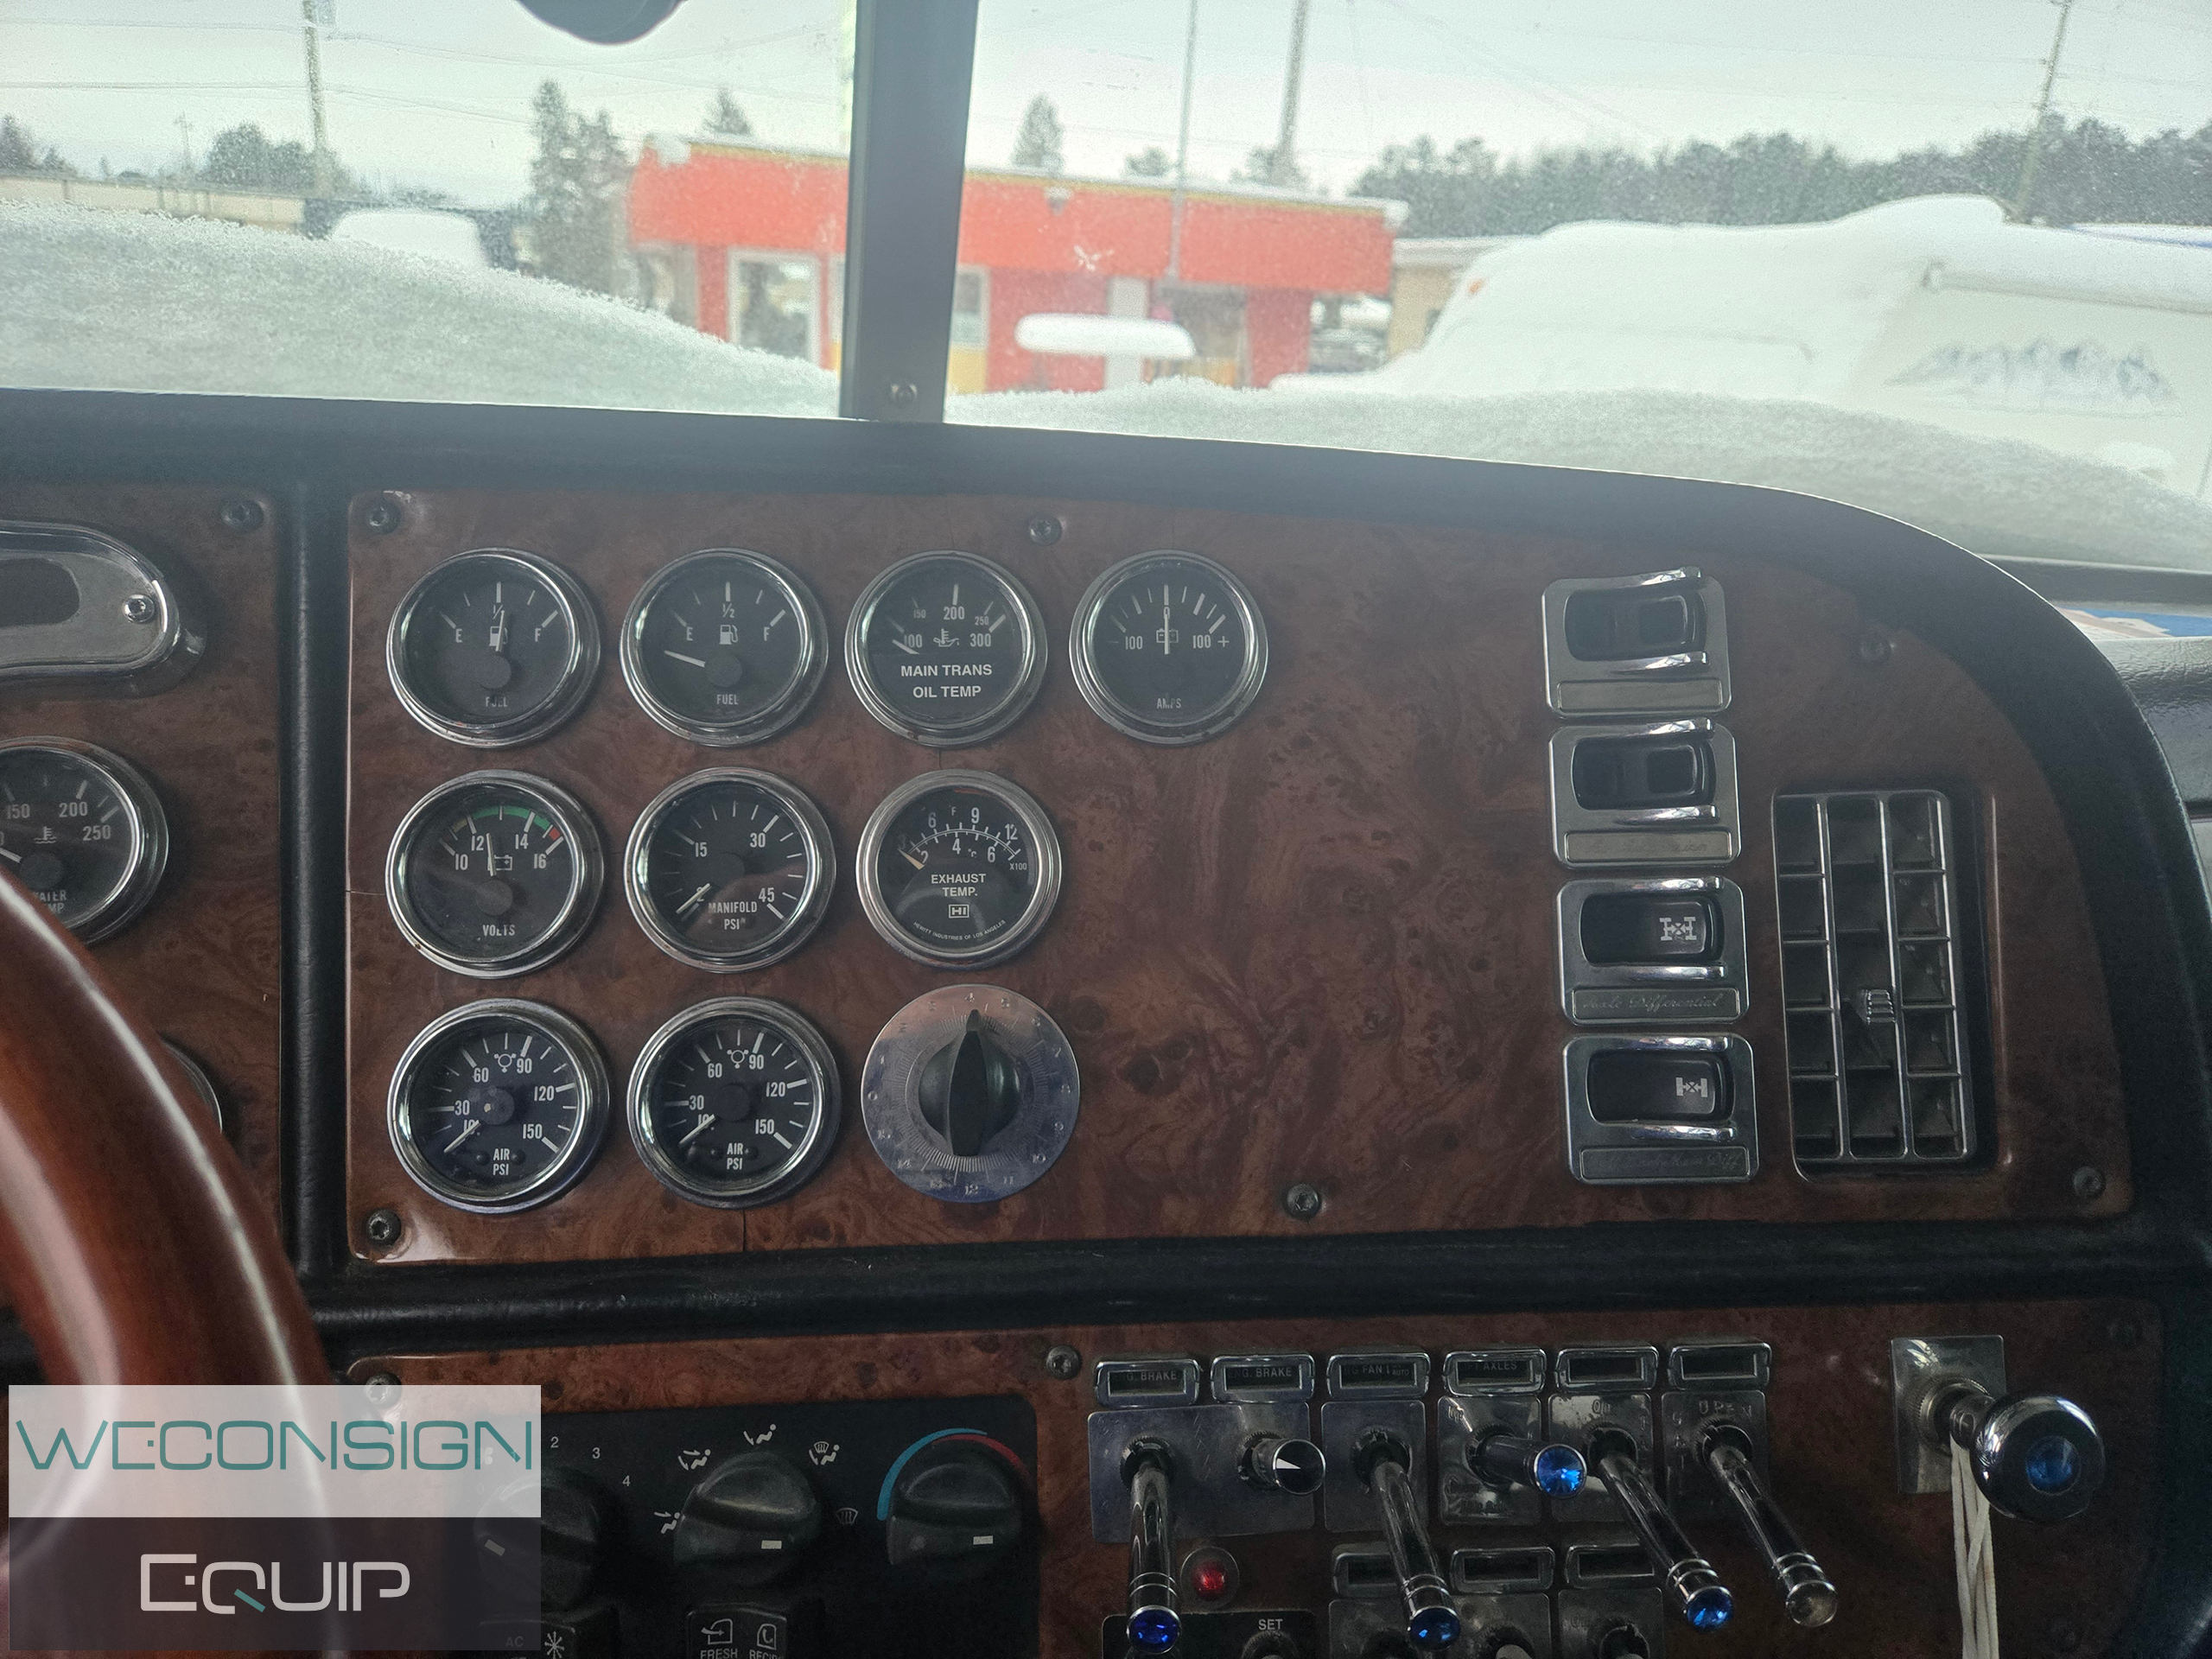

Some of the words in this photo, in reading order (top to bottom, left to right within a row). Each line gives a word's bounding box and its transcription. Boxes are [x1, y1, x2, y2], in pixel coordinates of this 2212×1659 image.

[912, 607, 926, 620] 150
[944, 606, 965, 620] 200
[975, 615, 989, 627] 250
[455, 629, 463, 643] E
[534, 628, 542, 642] F
[686, 627, 694, 642] E
[763, 627, 771, 641] F
[904, 634, 923, 648] 100
[969, 633, 992, 648] 300
[1125, 635, 1143, 651] 100
[900, 664, 943, 677] MAIN
[946, 664, 993, 677] TRANS
[912, 686, 938, 699] OIL
[940, 685, 982, 698] TEMP
[716, 694, 739, 706] FUEL
[1156, 697, 1182, 709] AMPS
[6, 804, 31, 819] 150
[59, 801, 88, 818] 200
[970, 807, 980, 823] 9
[928, 812, 937, 829] 6
[83, 825, 111, 842] 250
[1005, 823, 1019, 841] 12
[472, 836, 485, 851] 12
[516, 834, 530, 849] 14
[750, 832, 766, 848] 30
[952, 838, 962, 855] 4
[695, 842, 708, 858] 15
[987, 847, 996, 862] 6
[455, 854, 468, 870] 10
[534, 854, 547, 869] 16
[1009, 862, 1027, 871] X100
[931, 873, 987, 884] EXHAUST
[33, 890, 67, 902] ATER
[759, 887, 775, 902] 45
[942, 887, 978, 897] TEMP.
[708, 901, 758, 914] MANIFOLD
[950, 906, 967, 916] HI
[482, 925, 516, 936] VOLTS
[724, 918, 741, 931] PSI
[913, 921, 932, 935] HEWITT
[932, 931, 963, 940] INDUSTRIES
[984, 919, 1007, 935] ANGELES
[517, 1058, 532, 1074] 90
[748, 1054, 764, 1070] 90
[474, 1068, 489, 1084] 60
[707, 1063, 722, 1078] 60
[534, 1085, 555, 1102] 120
[766, 1082, 786, 1097] 120
[454, 1100, 470, 1116] 30
[690, 1095, 704, 1110] 30
[523, 1123, 543, 1139] 150
[755, 1119, 774, 1135] 150
[493, 1148, 510, 1161] AIR
[727, 1142, 743, 1155] AIR
[493, 1164, 509, 1176] PSI
[727, 1158, 742, 1170] PSI
[964, 1184, 979, 1196] 12
[1255, 1366, 1293, 1378] BRAKE
[1363, 1364, 1383, 1376] FAN
[1483, 1361, 1517, 1371] AXLES
[1141, 1370, 1178, 1381] BRAKE
[550, 1436, 559, 1449] 2
[592, 1446, 601, 1459] 3
[622, 1475, 631, 1487] 4
[1258, 1618, 1283, 1631] SET
[700, 1648, 739, 1659] FRESH
